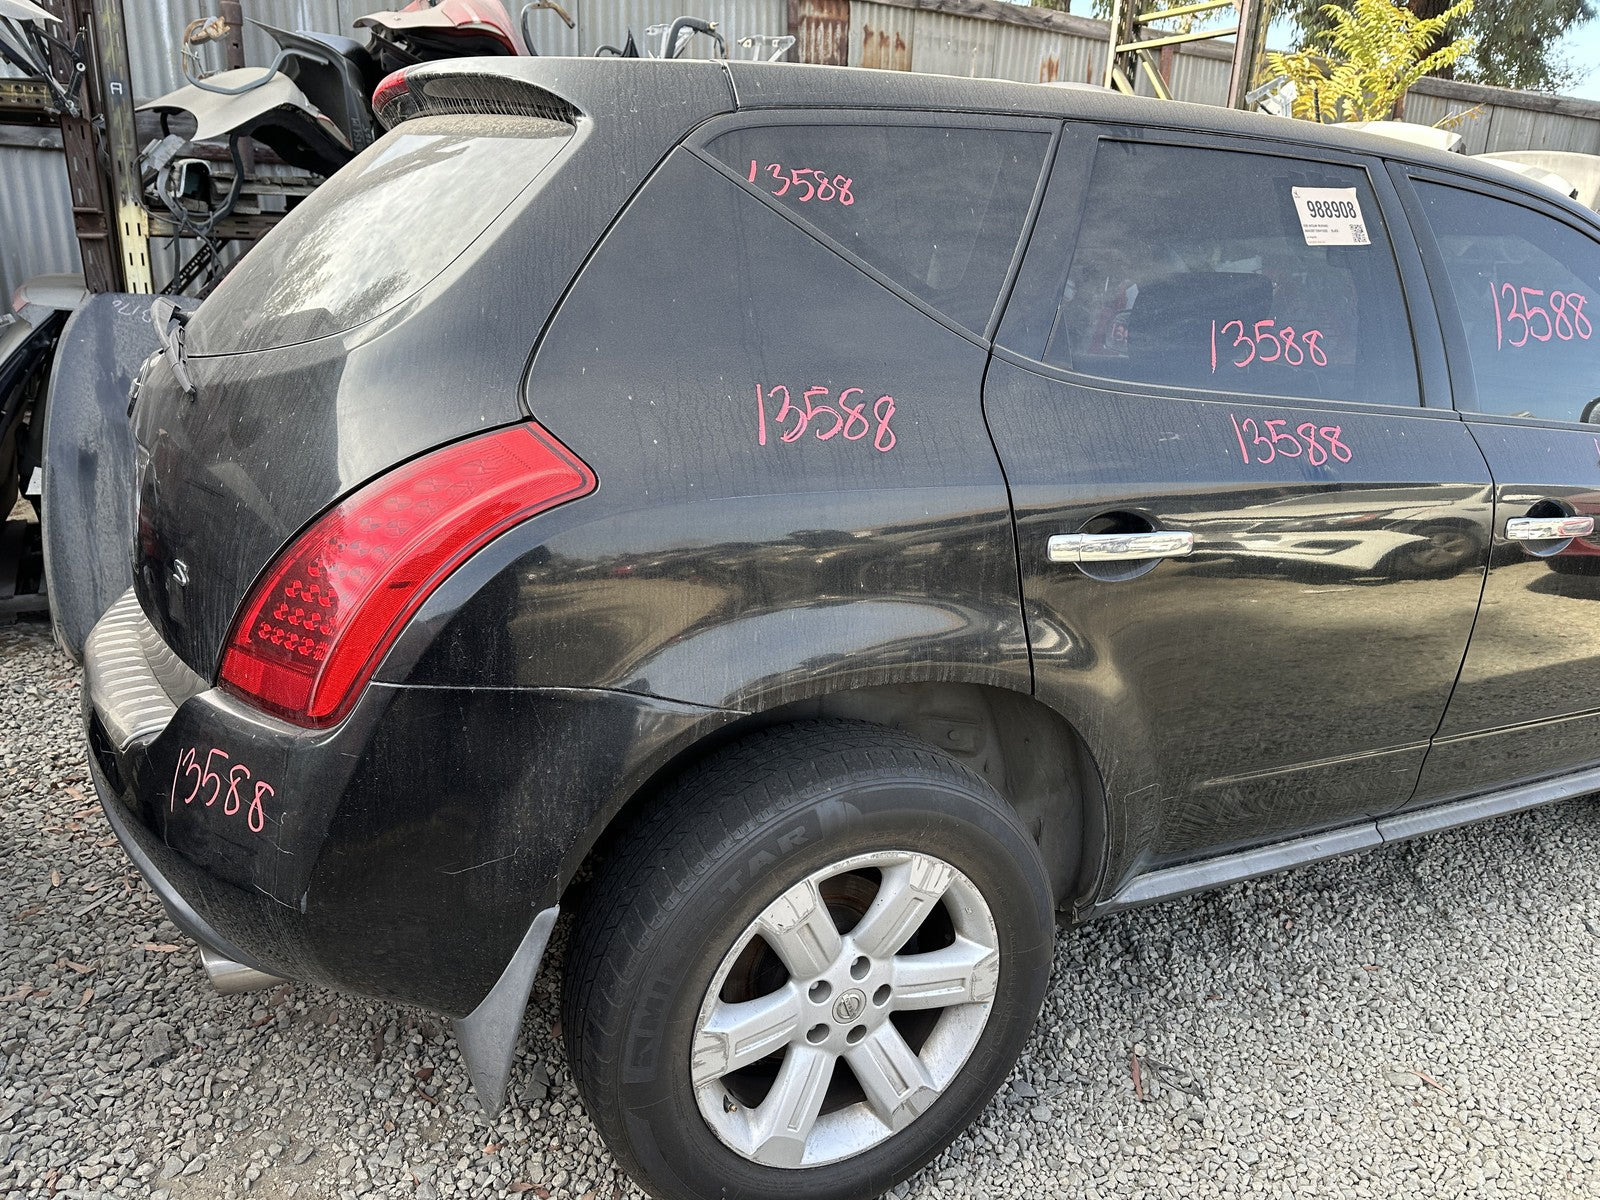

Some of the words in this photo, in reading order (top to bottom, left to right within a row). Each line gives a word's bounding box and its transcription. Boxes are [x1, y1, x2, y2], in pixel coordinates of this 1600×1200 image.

[748, 160, 856, 207] 13588
[1306, 200, 1357, 219] 988908
[1490, 282, 1593, 351] 13588
[1210, 319, 1327, 374] 13588
[756, 384, 897, 453] 13588
[1229, 413, 1353, 466] 13588
[173, 559, 189, 586] S
[170, 747, 275, 833] 13588
